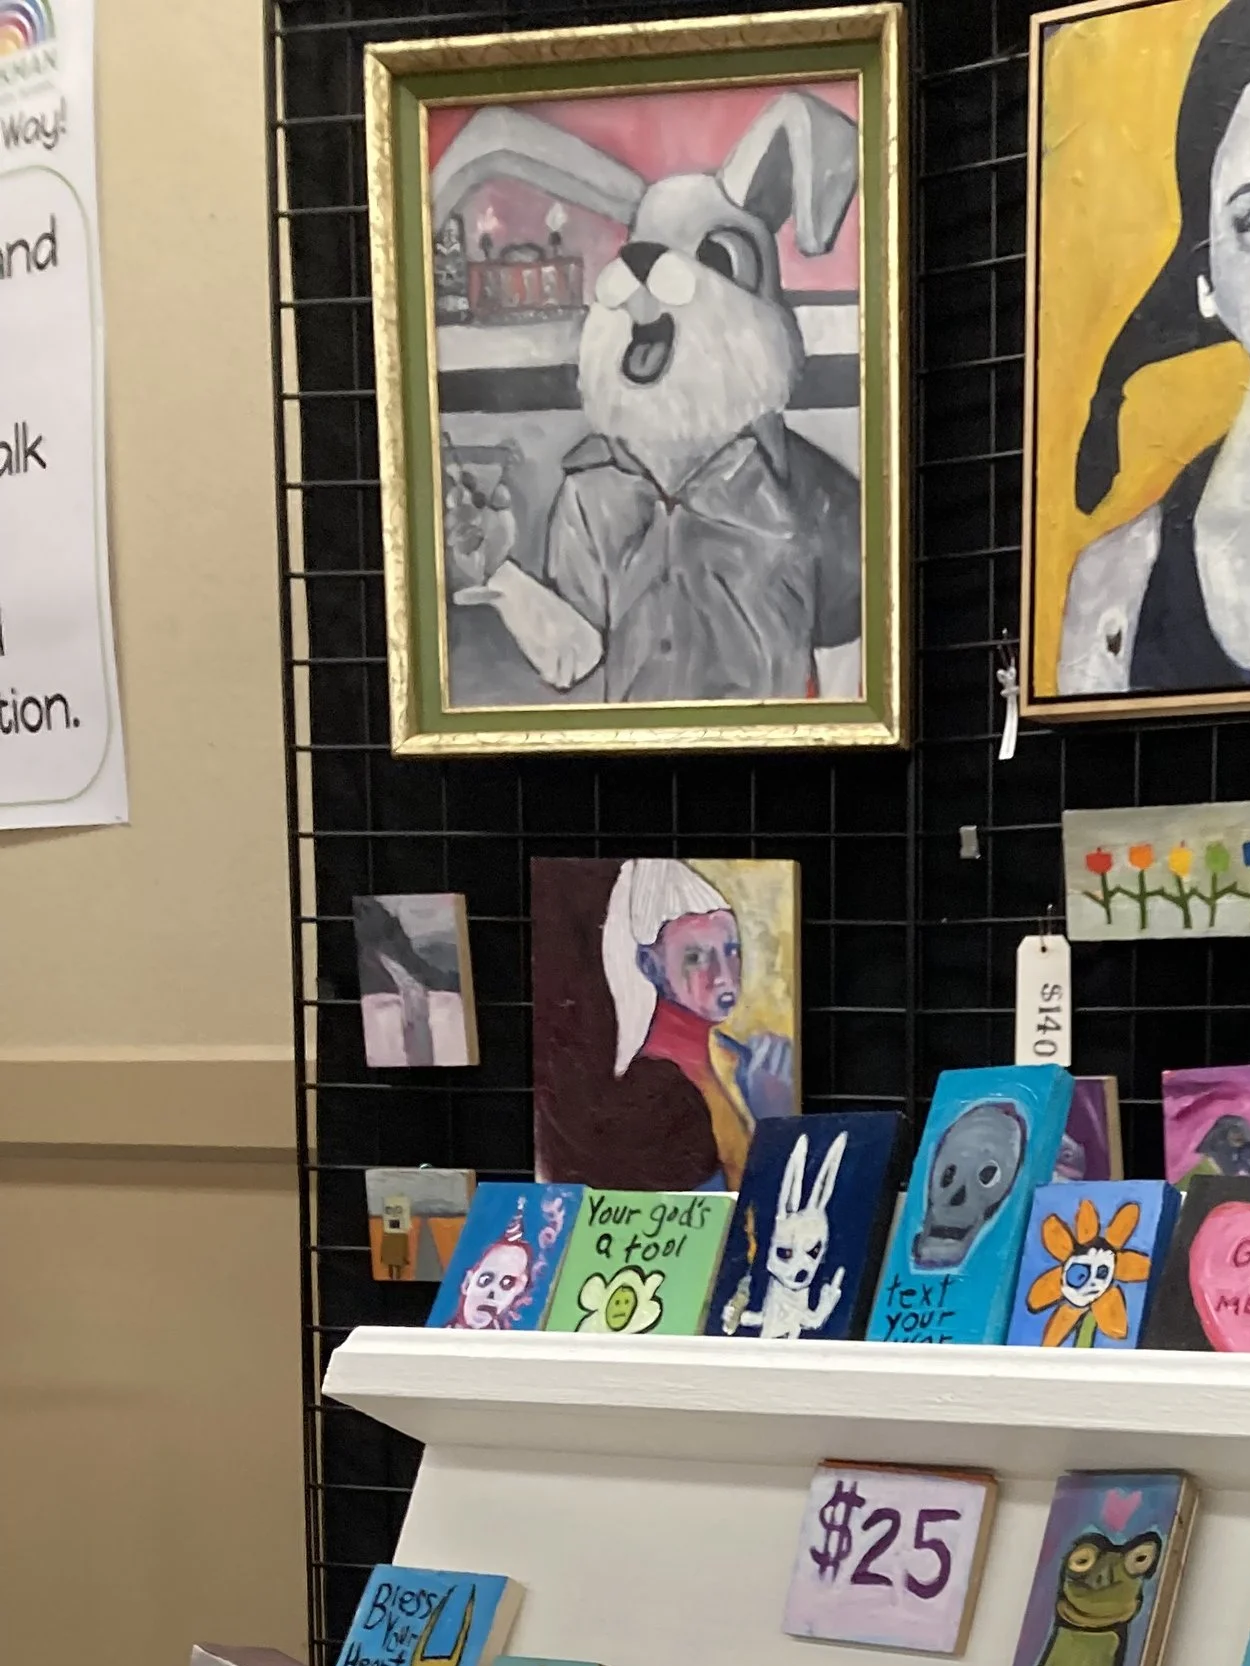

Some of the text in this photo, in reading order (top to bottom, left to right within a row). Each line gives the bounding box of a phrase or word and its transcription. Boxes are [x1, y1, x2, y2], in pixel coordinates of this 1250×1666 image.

[1, 95, 67, 150] Way!
[0, 212, 58, 280] nd
[1033, 983, 1063, 1057] $140
[588, 1195, 711, 1238] Your god's
[625, 1234, 688, 1263] tool
[887, 1274, 957, 1309] text
[884, 1311, 956, 1342] your
[809, 1480, 962, 1599] $25
[363, 1582, 438, 1630] Bless
